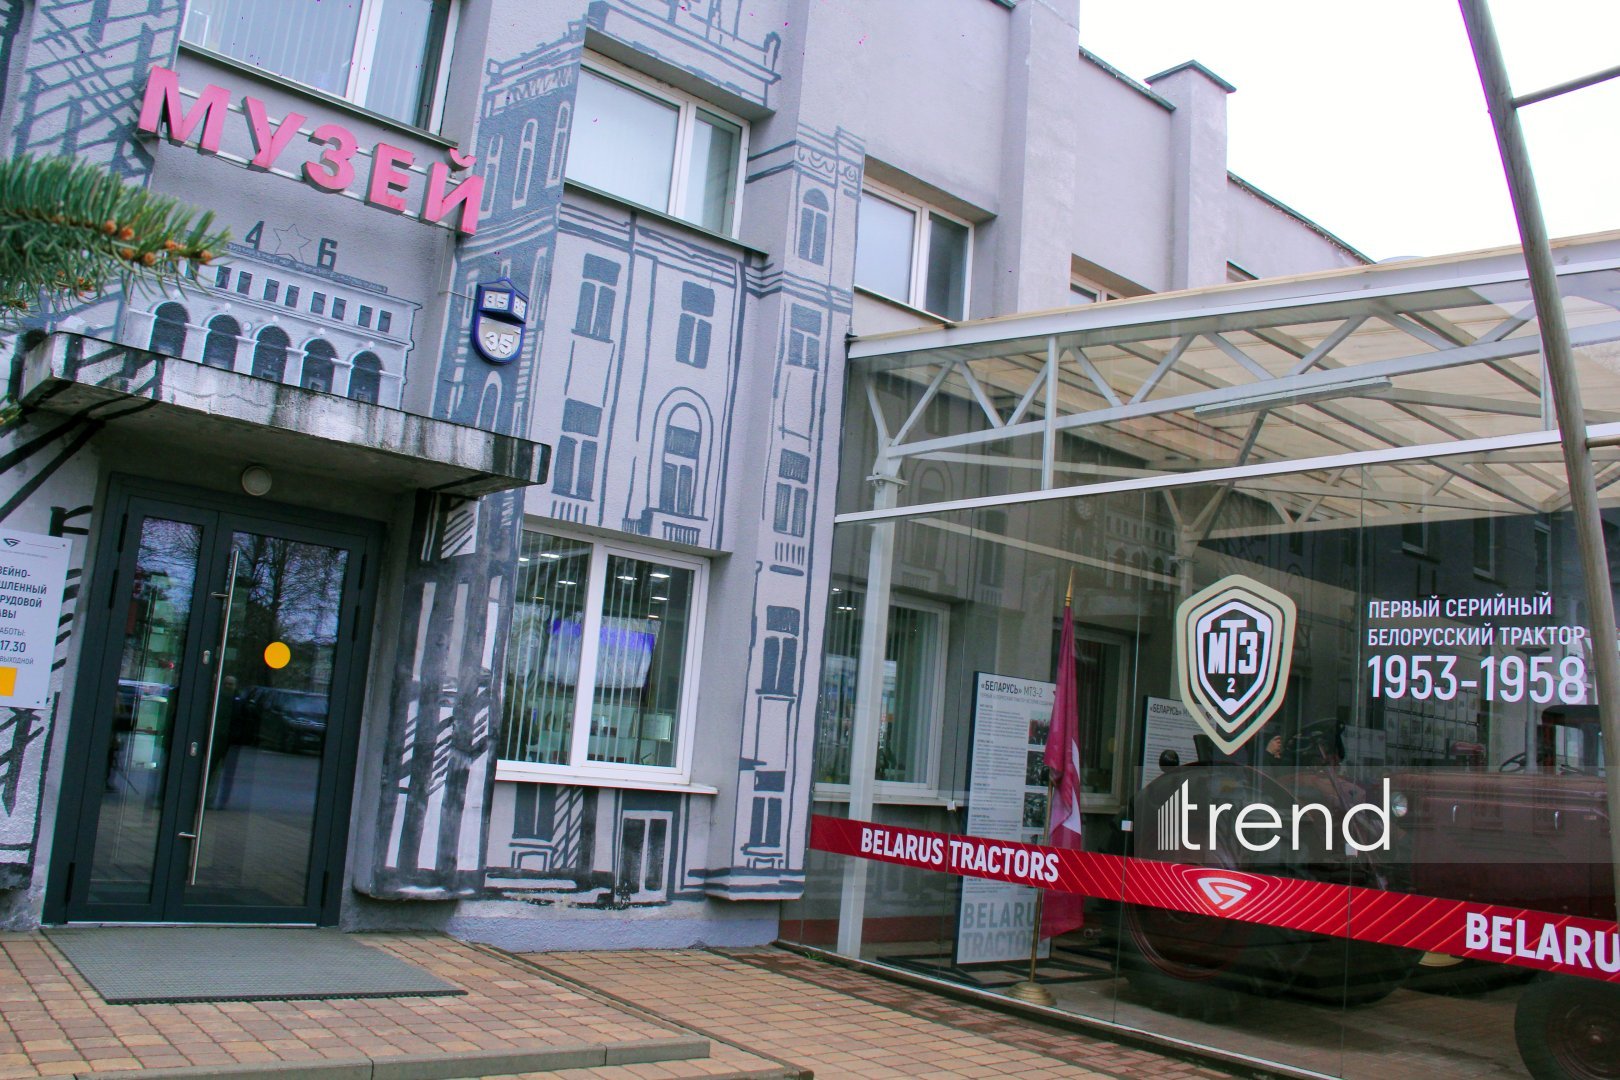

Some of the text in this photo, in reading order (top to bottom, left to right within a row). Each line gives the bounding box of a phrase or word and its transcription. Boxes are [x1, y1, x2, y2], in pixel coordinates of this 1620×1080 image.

[135, 65, 485, 237] МУЗЕЙ
[244, 220, 338, 271] 4 6
[485, 331, 514, 355] 35
[0, 580, 47, 595] ШЛЕННЫЙ
[1368, 592, 1551, 619] ПЕРВЫЙ СЕРИЙНЫЙ
[0, 639, 27, 653] 17.30
[1207, 619, 1258, 674] МТЗ
[1368, 622, 1585, 647] БЕЛОРУССКИЙ ТРАКТОР
[1226, 678, 1236, 693] 2
[1367, 654, 1586, 704] 1953-1958
[861, 827, 1059, 883] BELARUS TRACTORS
[1465, 911, 1620, 973] BELARU
